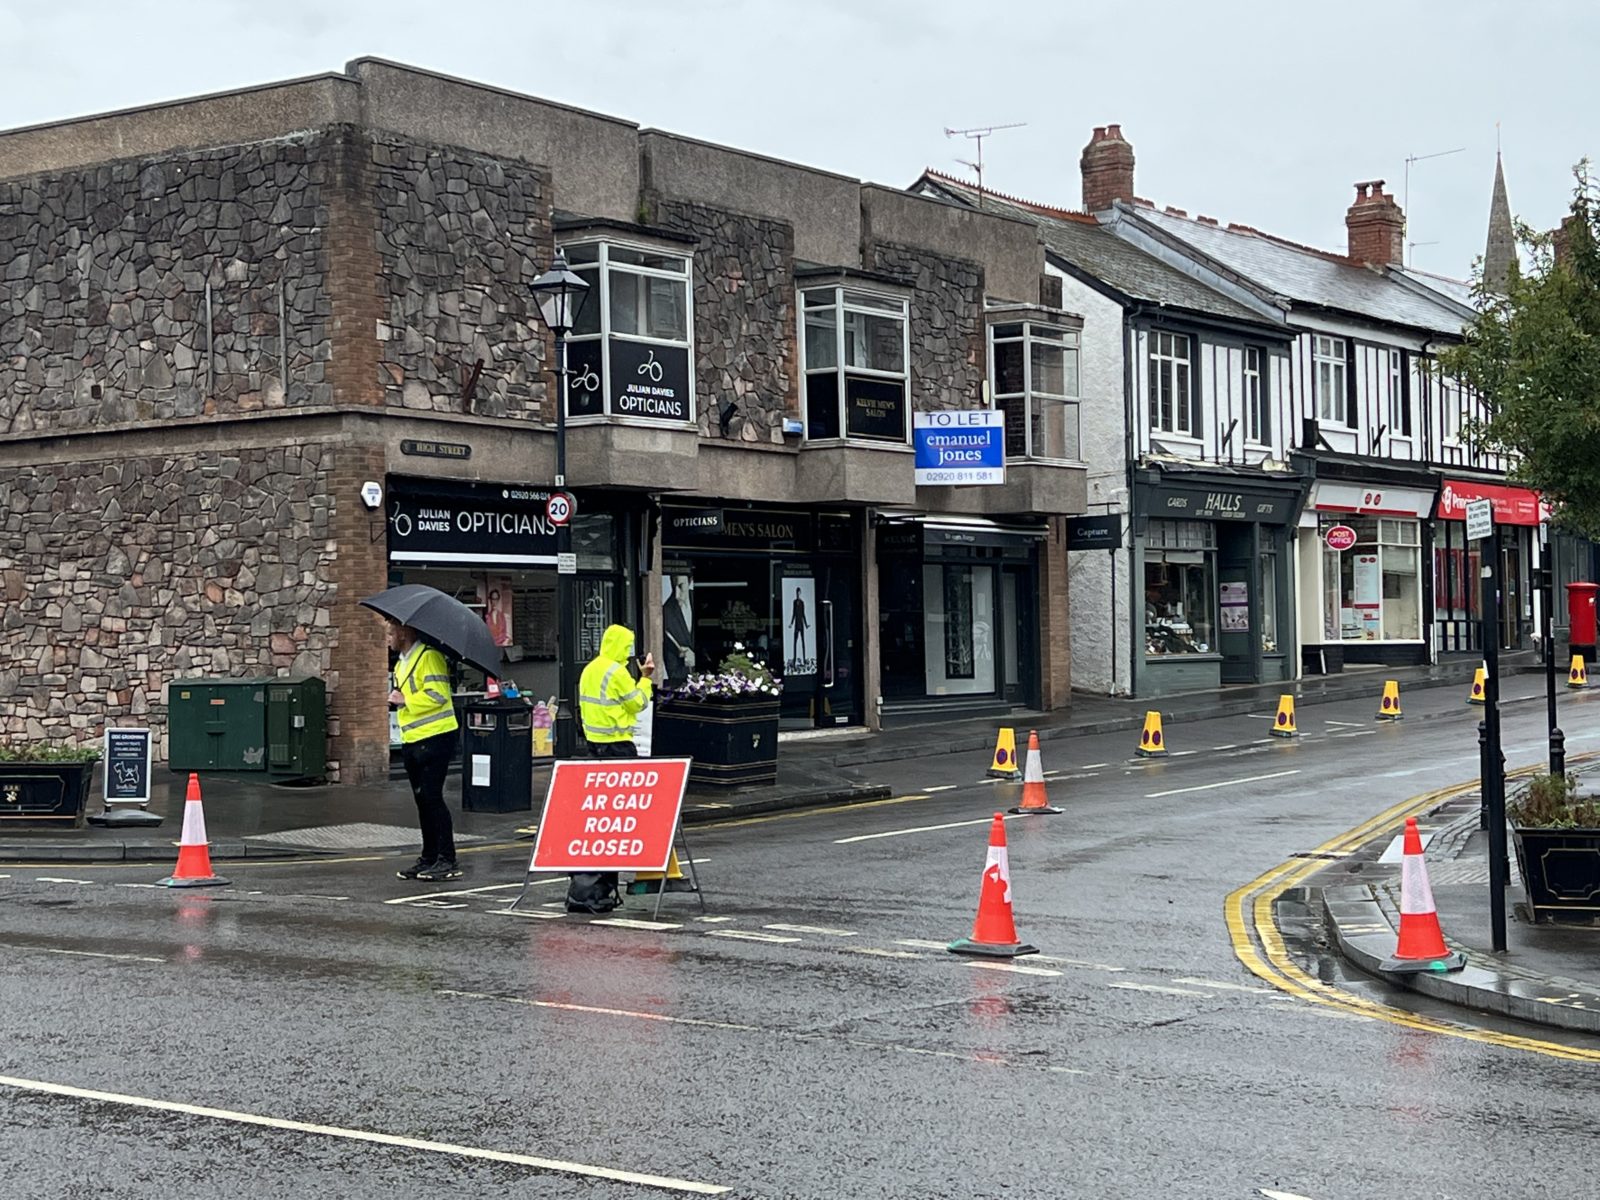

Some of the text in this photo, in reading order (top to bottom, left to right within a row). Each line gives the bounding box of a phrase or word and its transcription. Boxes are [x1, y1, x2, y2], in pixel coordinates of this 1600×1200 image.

[626, 384, 675, 398] JULIAN DAVIES
[619, 395, 682, 416] OPTICIANS
[925, 412, 993, 426] TO LET
[926, 430, 991, 446] emanuel
[416, 442, 466, 456] HIGH STREET
[937, 449, 982, 466] jones
[926, 471, 993, 481] 02920 811 581
[550, 503, 568, 515] 20
[1167, 497, 1188, 508] CARDS
[1205, 493, 1242, 511] HALLS
[1257, 503, 1274, 514] GIFTS
[418, 509, 450, 520] JULIAN
[673, 516, 718, 527] OPTICIANS
[418, 521, 450, 532] DAVIES
[456, 511, 557, 536] OPTICIANS
[722, 521, 794, 538] MEN'S SALON
[1077, 527, 1109, 538] Capture
[1332, 530, 1350, 538] POST
[584, 771, 659, 788] FFORDD
[581, 793, 653, 811] AR GAU
[584, 816, 637, 833] ROAD
[567, 839, 644, 857] CLOSED
